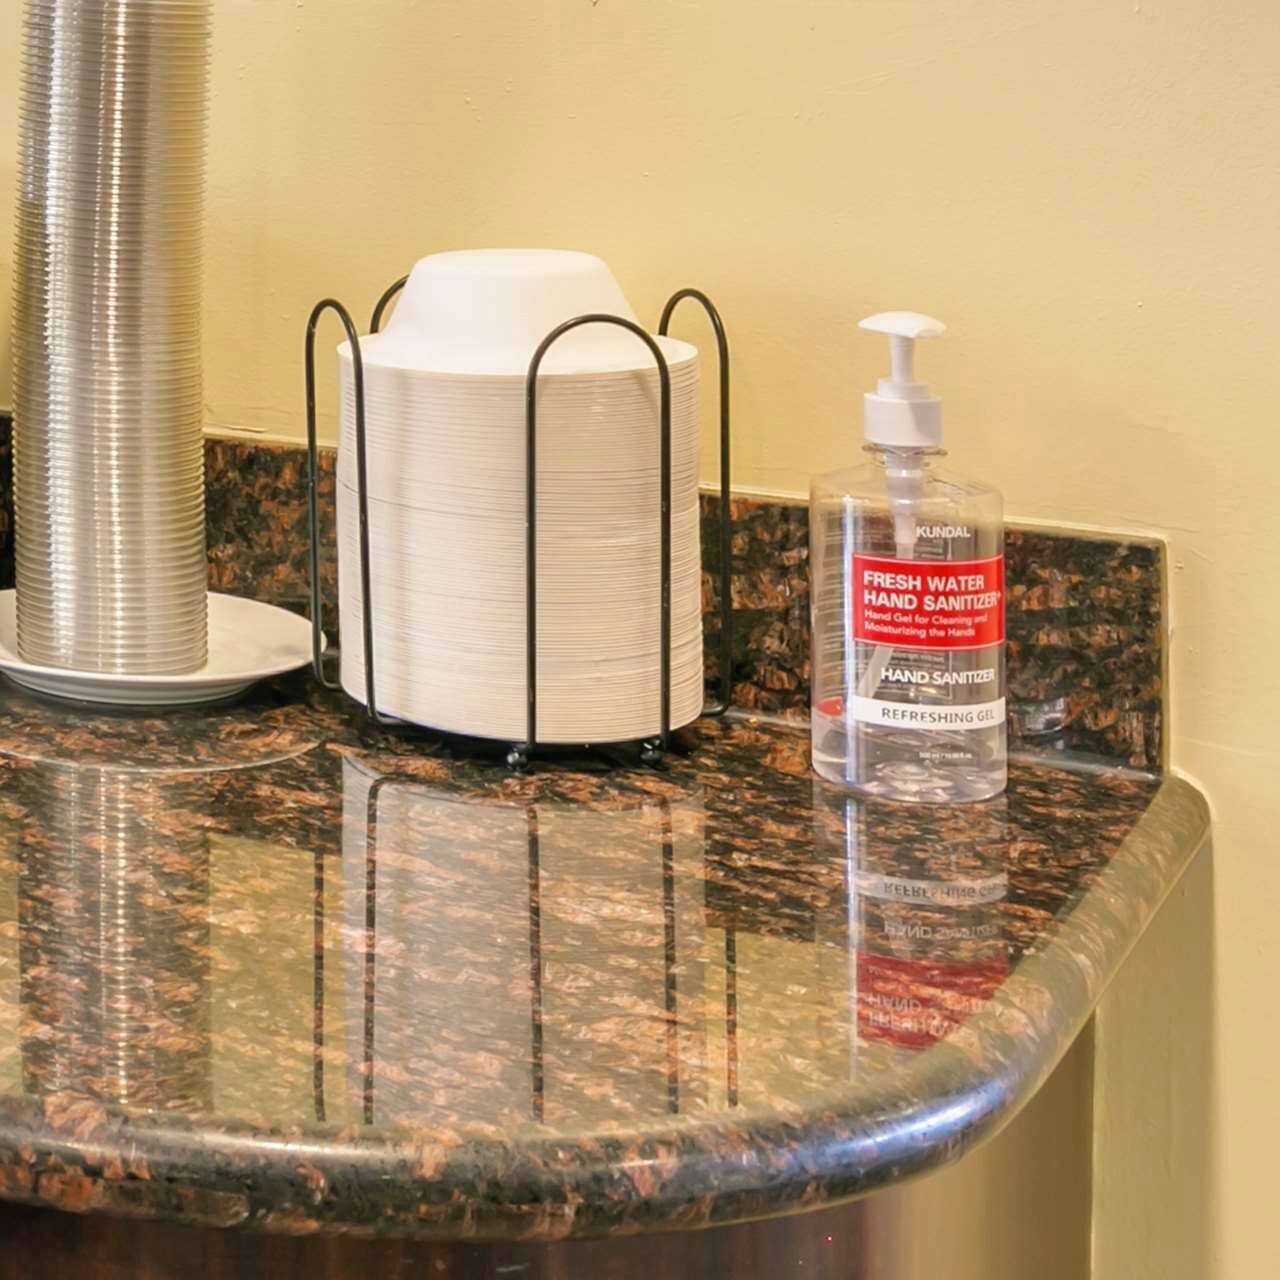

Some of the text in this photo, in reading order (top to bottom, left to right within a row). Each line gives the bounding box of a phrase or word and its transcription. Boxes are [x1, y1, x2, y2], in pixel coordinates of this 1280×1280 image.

[915, 526, 971, 538] KUNDAL
[863, 571, 985, 592] FRESH WATER
[864, 590, 918, 610] HAND
[864, 609, 892, 621] Hand
[893, 612, 912, 623] Gel
[915, 614, 930, 624] for
[931, 615, 973, 626] Cleaning
[864, 621, 976, 638] Moisturizing the Hands
[880, 667, 995, 685] HAND SANITIZER
[881, 707, 995, 724] REFRESHING GEL
